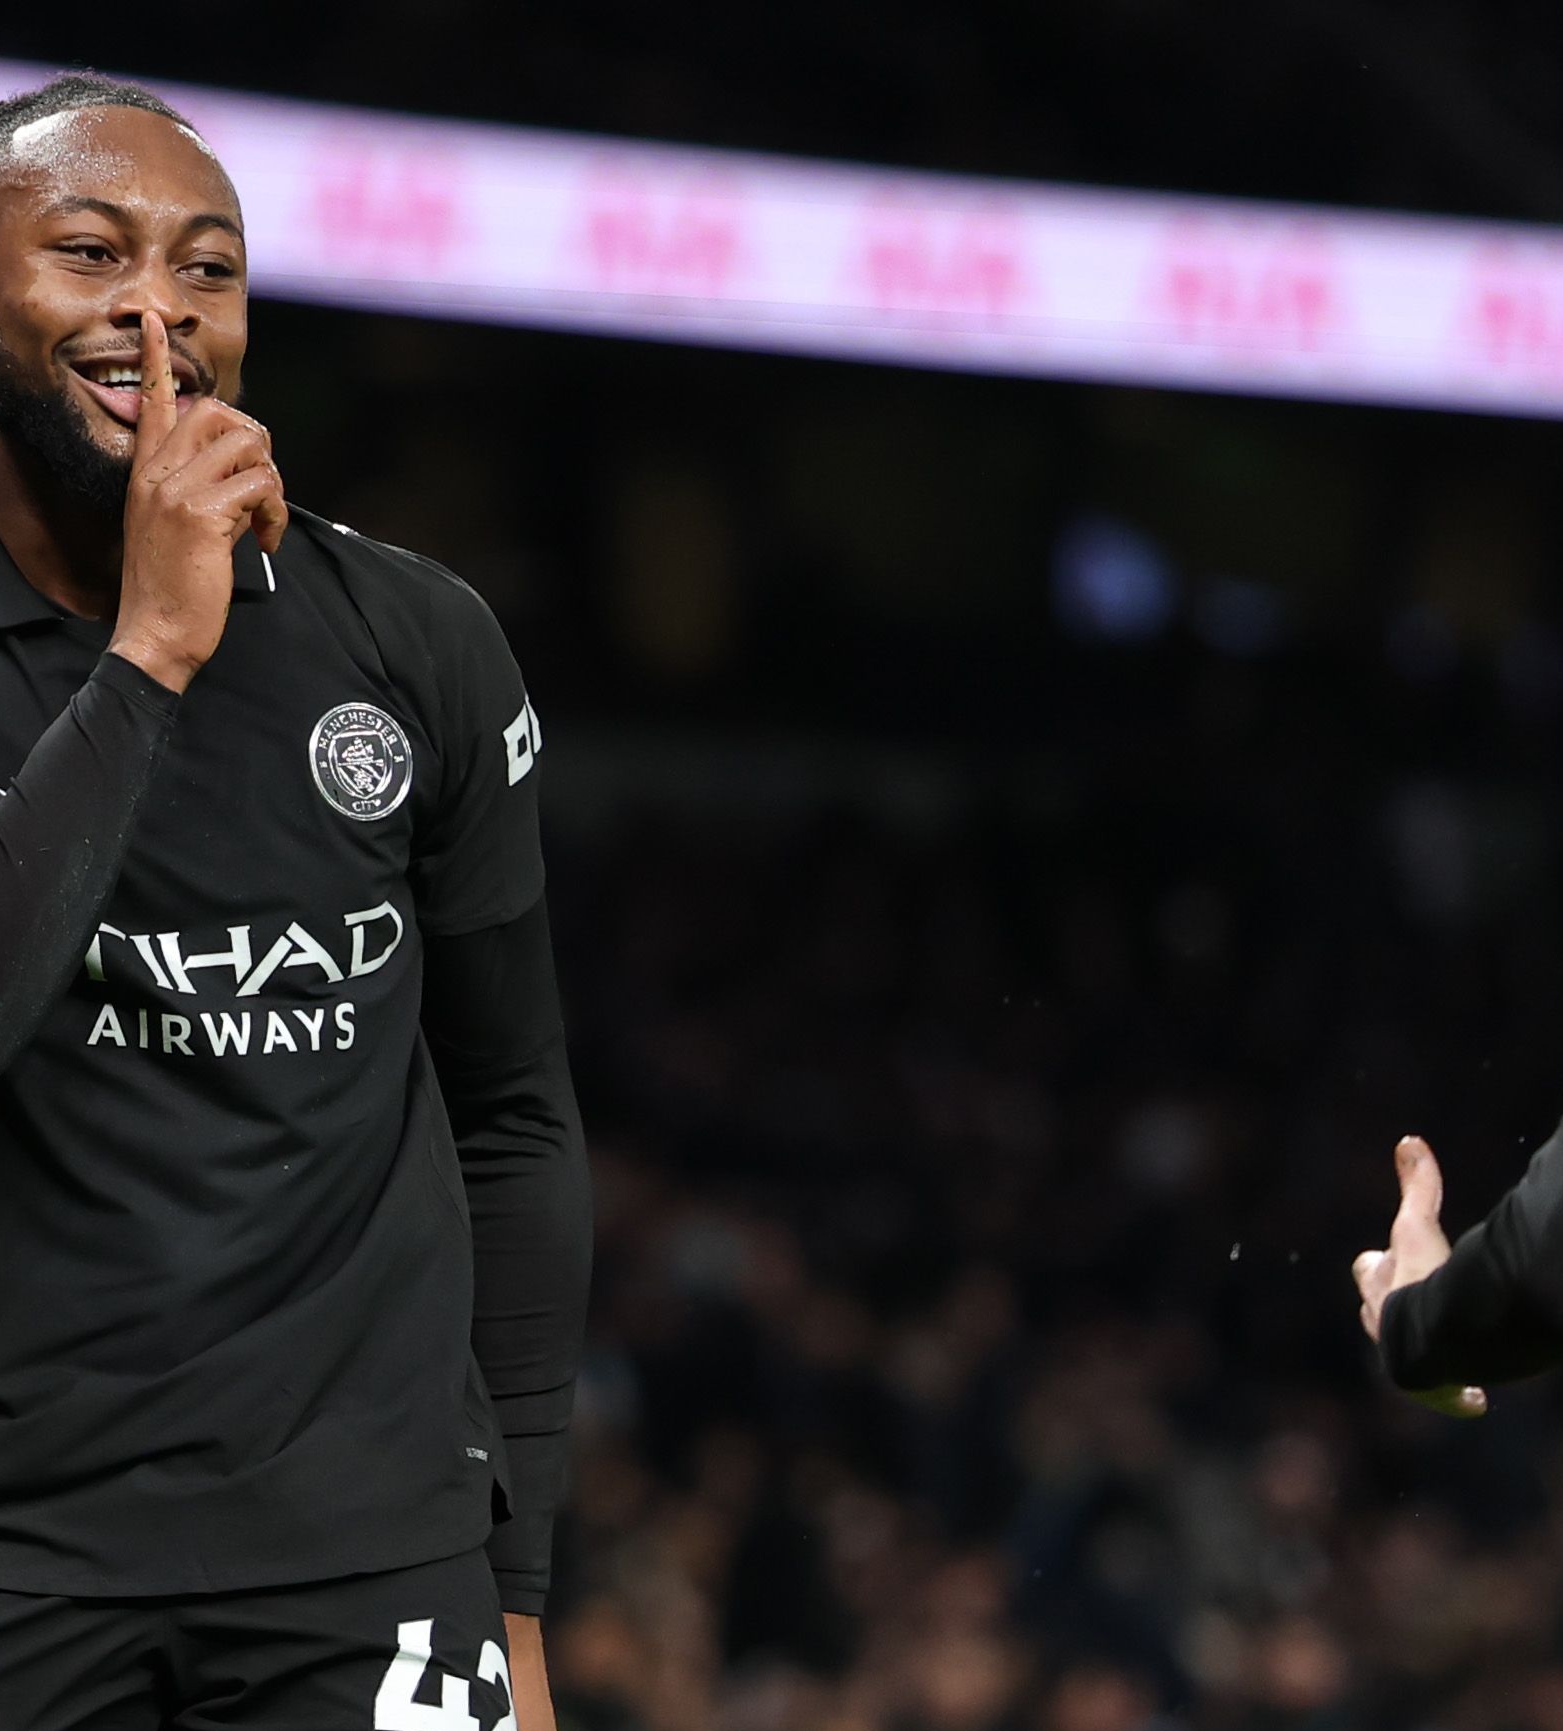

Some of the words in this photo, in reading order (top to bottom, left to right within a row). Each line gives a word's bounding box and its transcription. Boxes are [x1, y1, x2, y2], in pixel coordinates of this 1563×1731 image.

[318, 711, 398, 750] MANCHESTER
[352, 798, 382, 812] CITY
[85, 900, 404, 997] TIHAD
[86, 1002, 355, 1057] AIRWAYS
